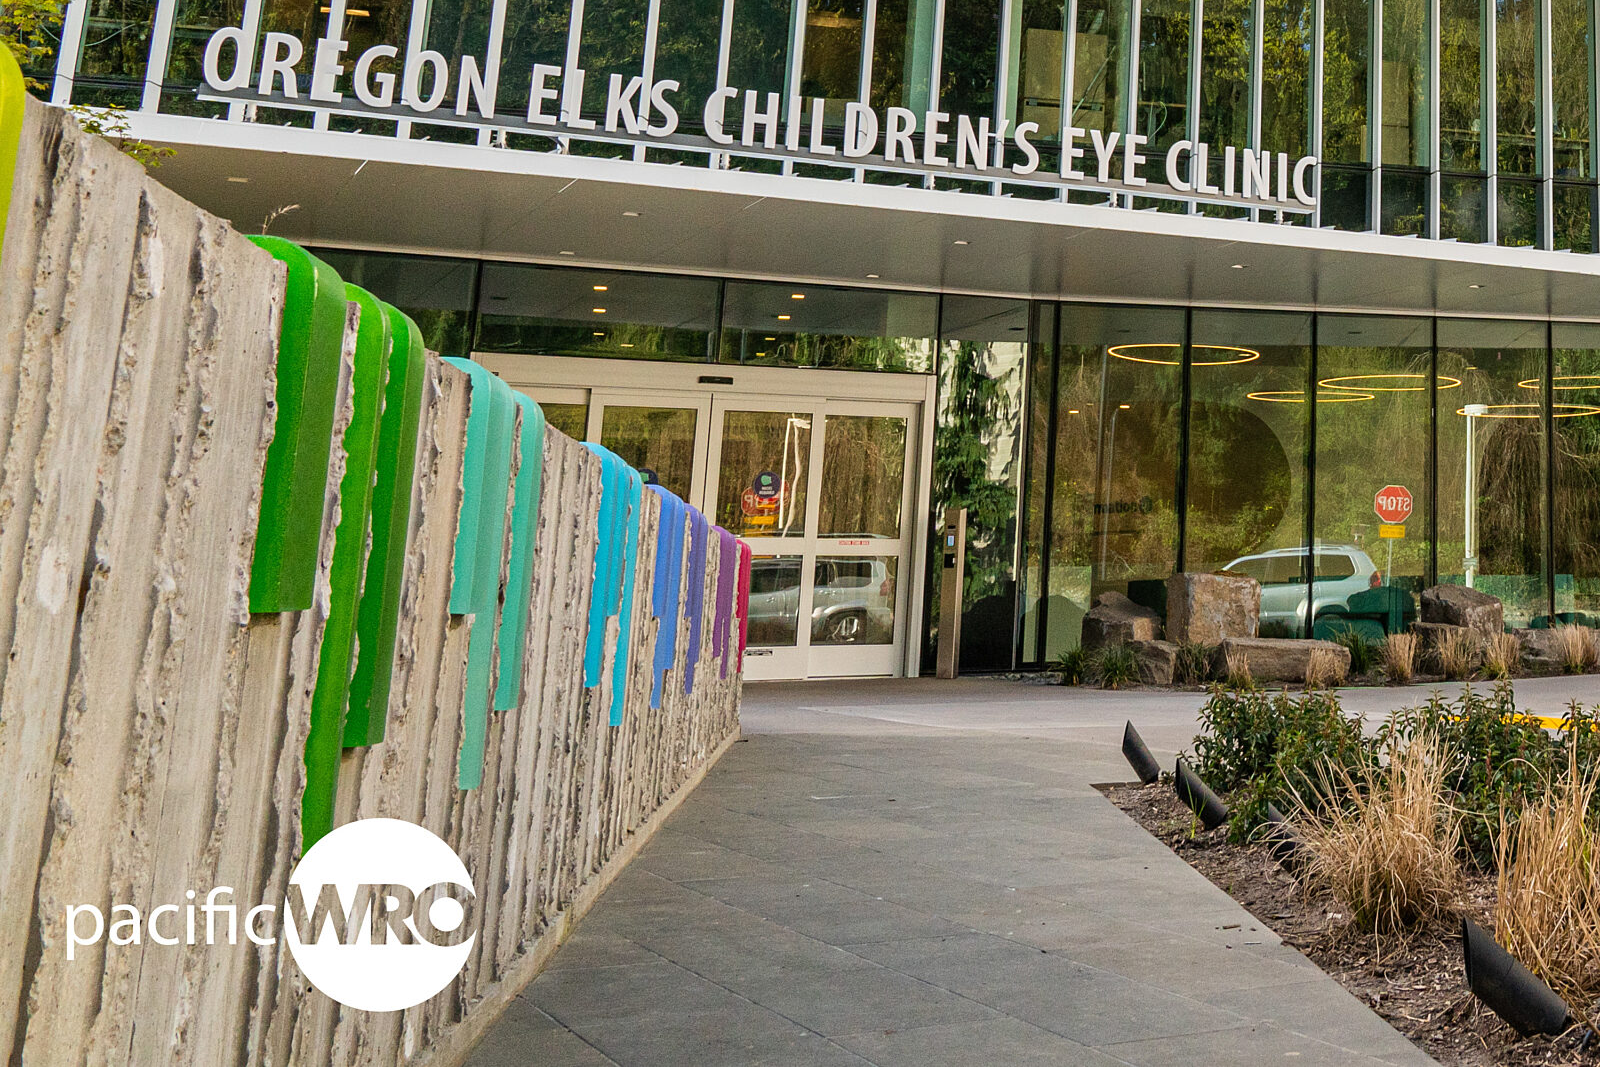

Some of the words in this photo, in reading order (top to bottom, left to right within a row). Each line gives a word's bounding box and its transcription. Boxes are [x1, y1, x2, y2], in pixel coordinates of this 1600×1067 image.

[203, 26, 496, 119] OREGON
[527, 63, 683, 136] ELKS
[703, 86, 1040, 175] CHILDREN'S
[1060, 126, 1148, 187] EYE
[1165, 139, 1319, 206] CLINIC
